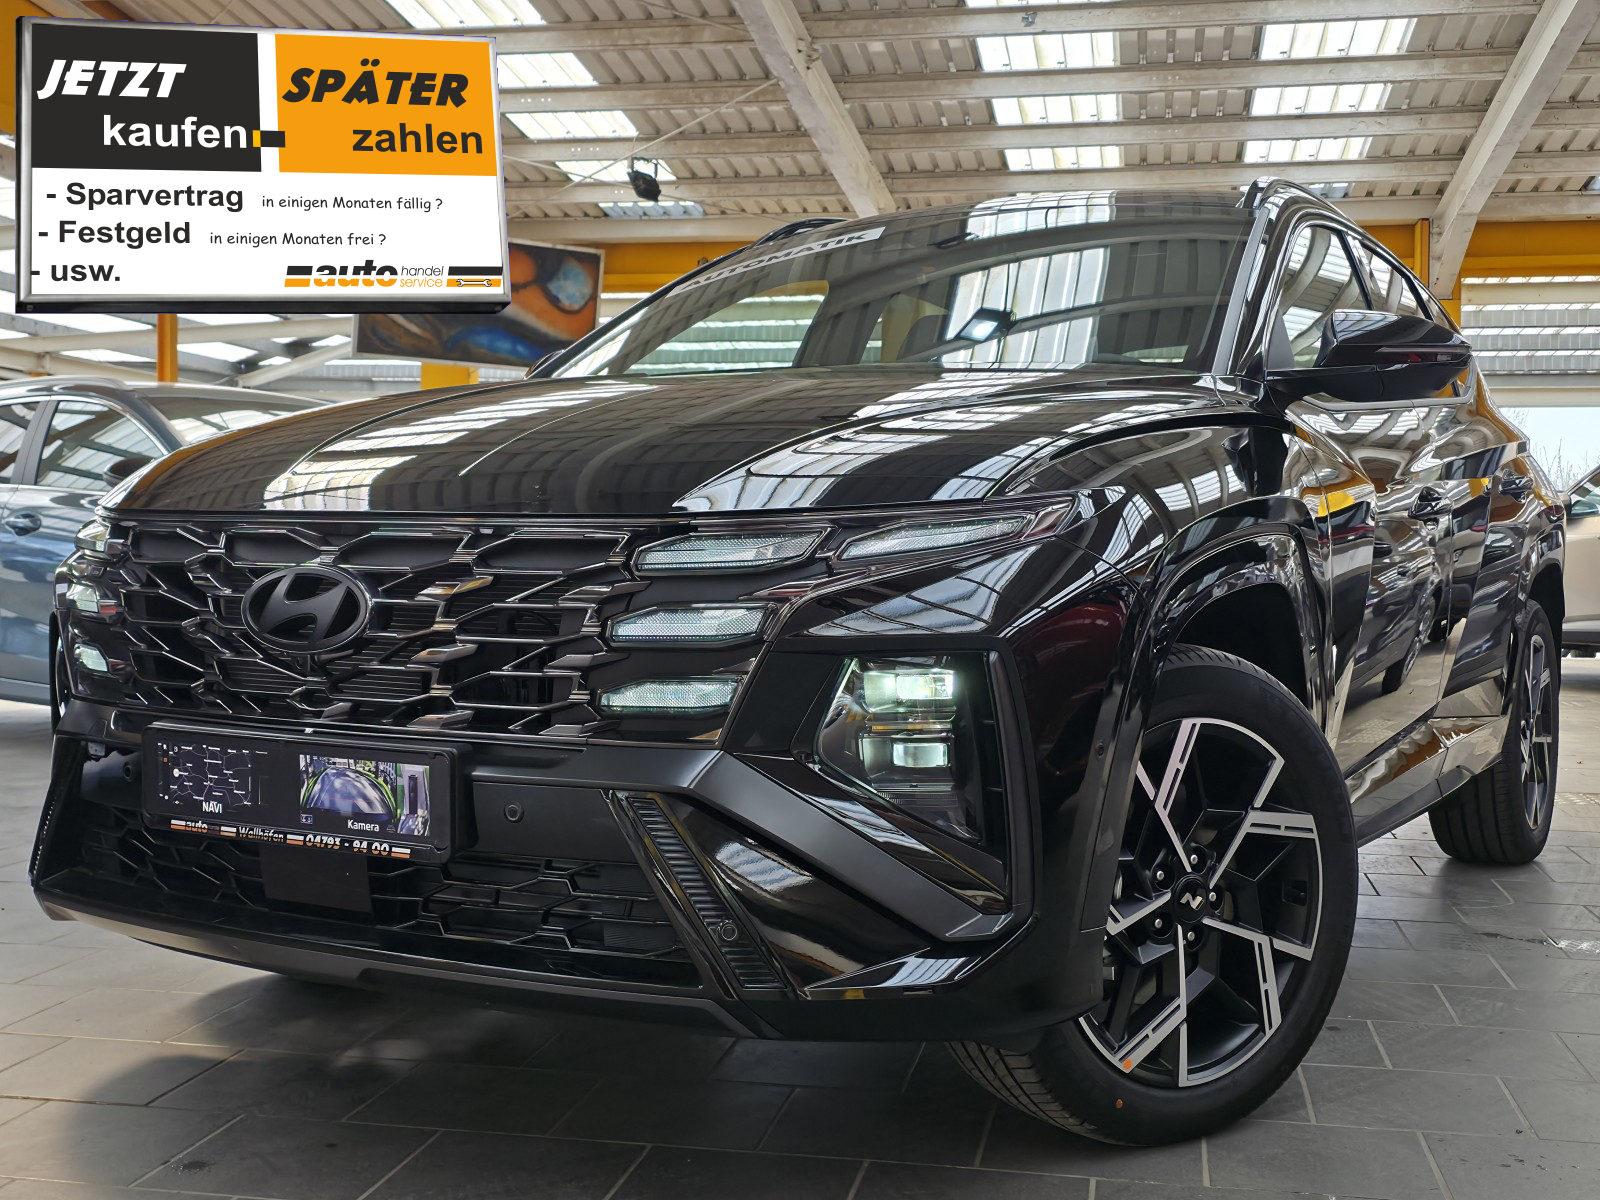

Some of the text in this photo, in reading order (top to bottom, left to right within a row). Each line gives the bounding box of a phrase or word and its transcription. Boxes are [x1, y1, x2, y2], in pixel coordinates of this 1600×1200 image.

[681, 233, 866, 290] AUTOMATIK
[202, 801, 223, 814] NAVI
[347, 819, 380, 832] Kamera
